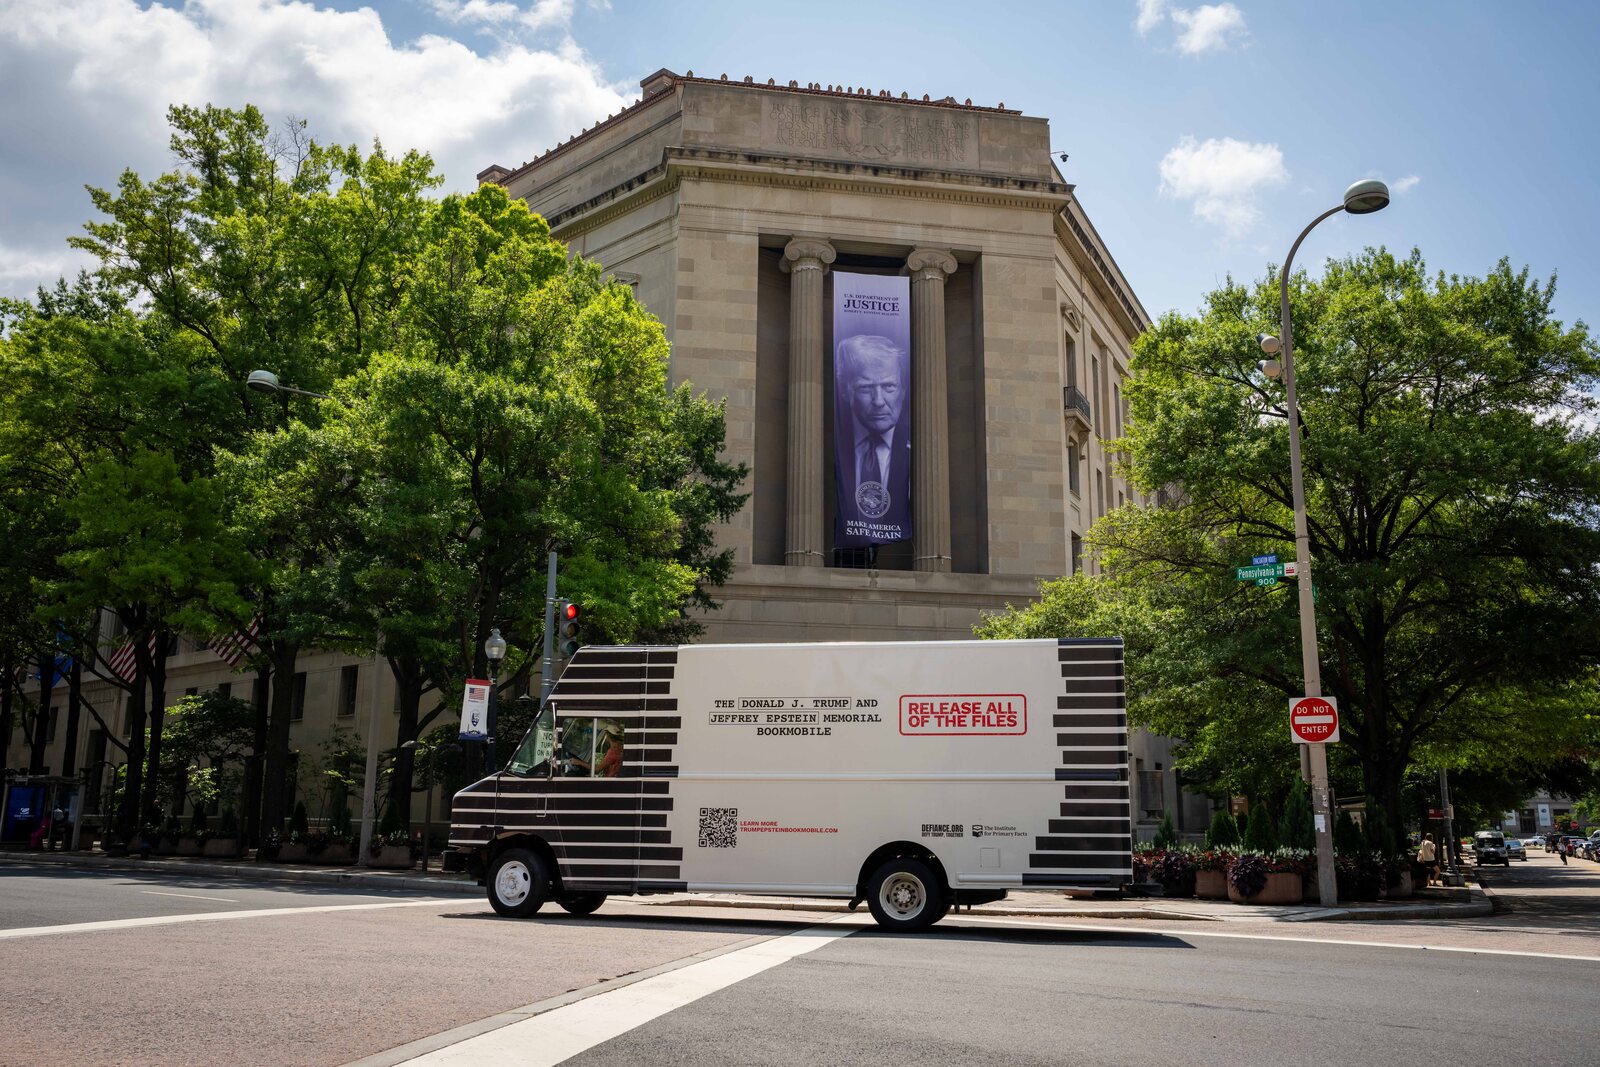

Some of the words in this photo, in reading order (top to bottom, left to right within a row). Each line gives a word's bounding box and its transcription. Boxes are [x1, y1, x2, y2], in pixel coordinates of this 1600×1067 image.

[844, 299, 900, 312] JUSTICE
[846, 528, 871, 537] SAFE
[872, 531, 902, 539] AGAIN
[1238, 567, 1275, 579] Pennsylvania
[714, 700, 735, 708] THE
[741, 700, 784, 708] DONALD
[791, 700, 804, 708] J.
[813, 699, 849, 708] TRUMP
[856, 699, 878, 708] AND
[908, 702, 982, 714] RELEASE
[986, 702, 1017, 714] ALL
[710, 714, 759, 723] JEFFREY
[766, 714, 816, 723] EPSTEIN
[823, 714, 882, 722] MEMORIAL
[908, 715, 930, 727] OF
[934, 715, 967, 727] THE
[972, 715, 1018, 727] FILES
[757, 727, 831, 736] BOOKMOBILE
[922, 824, 963, 832] DEFIANCE.ORG
